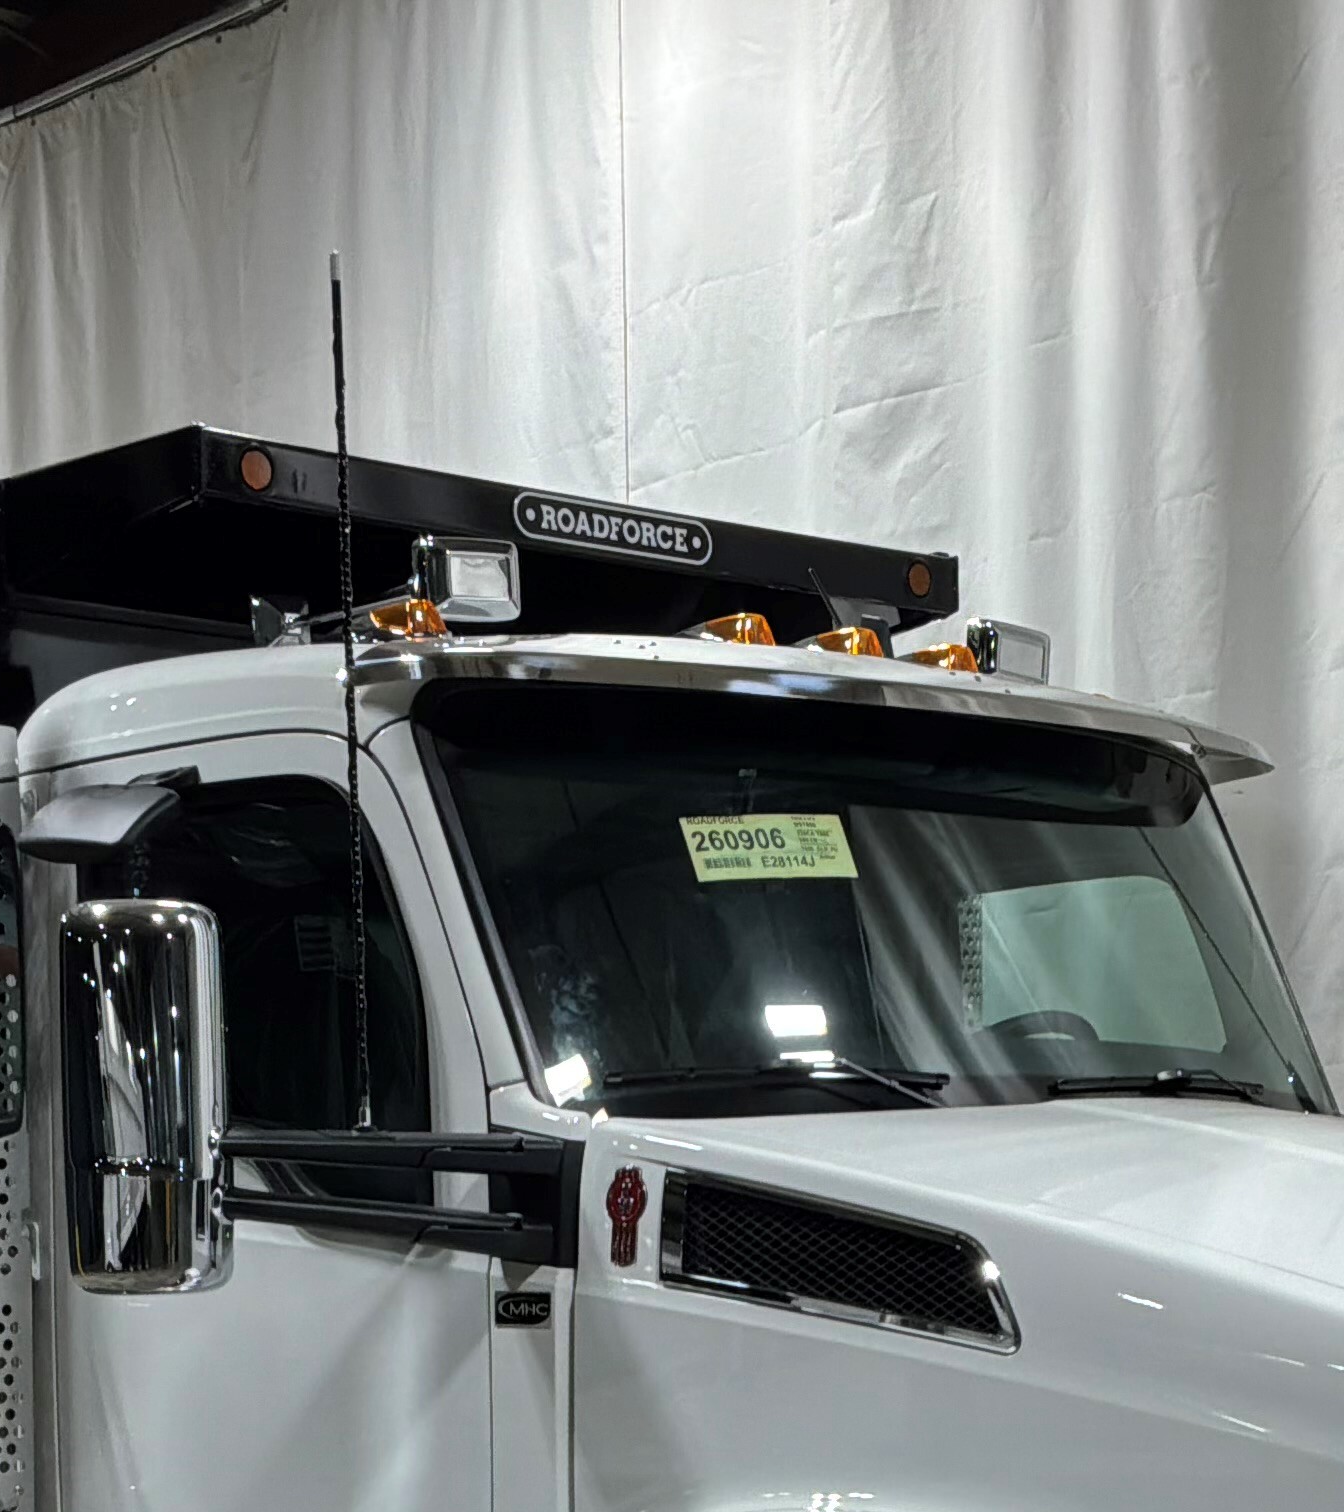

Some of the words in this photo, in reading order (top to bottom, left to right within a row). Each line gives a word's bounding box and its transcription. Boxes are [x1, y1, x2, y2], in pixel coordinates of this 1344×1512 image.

[540, 504, 688, 552] ROADFORCE
[690, 828, 786, 852] 260906
[509, 1302, 549, 1316] MHC
